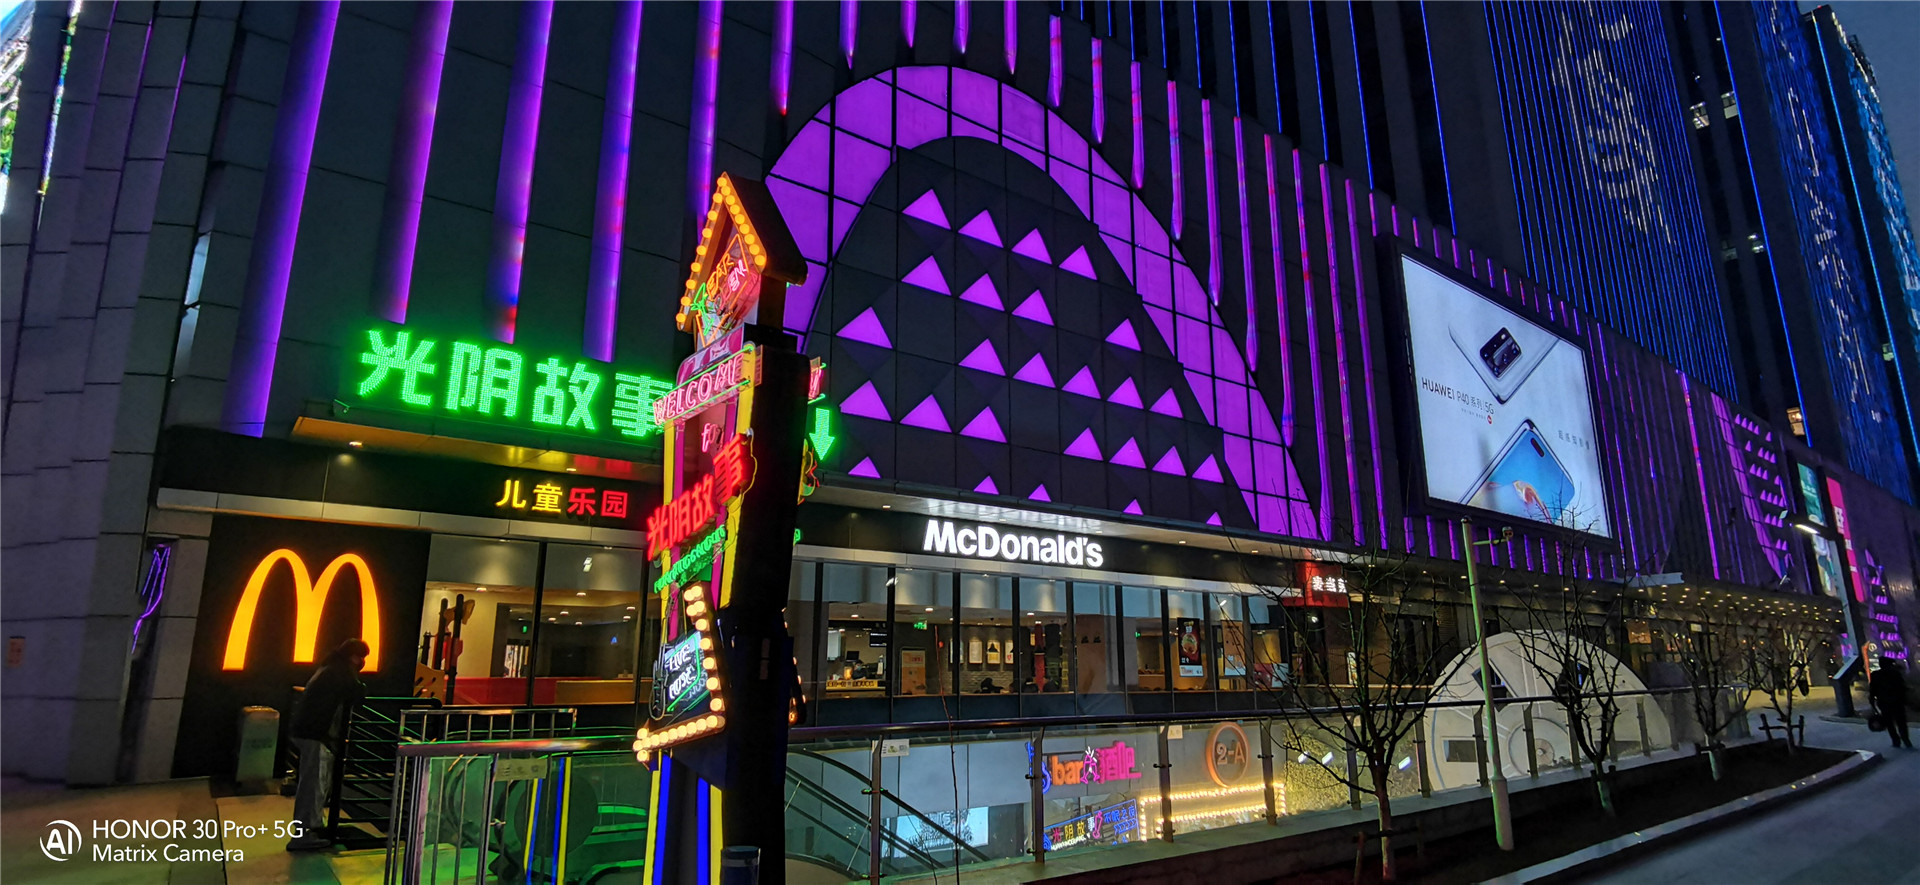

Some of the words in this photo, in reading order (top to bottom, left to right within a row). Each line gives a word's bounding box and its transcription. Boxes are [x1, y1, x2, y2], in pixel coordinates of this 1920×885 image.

[360, 329, 674, 438] 光阴故事
[653, 353, 747, 425] WELCOME
[1421, 377, 1455, 401] HUAWEI
[496, 479, 629, 520] 儿童乐园
[646, 432, 747, 562] 光阴故事
[923, 518, 1104, 568] McDonald's
[1050, 754, 1086, 786] bar
[1096, 741, 1142, 784] 酒吧
[1216, 742, 1246, 766] 2-A
